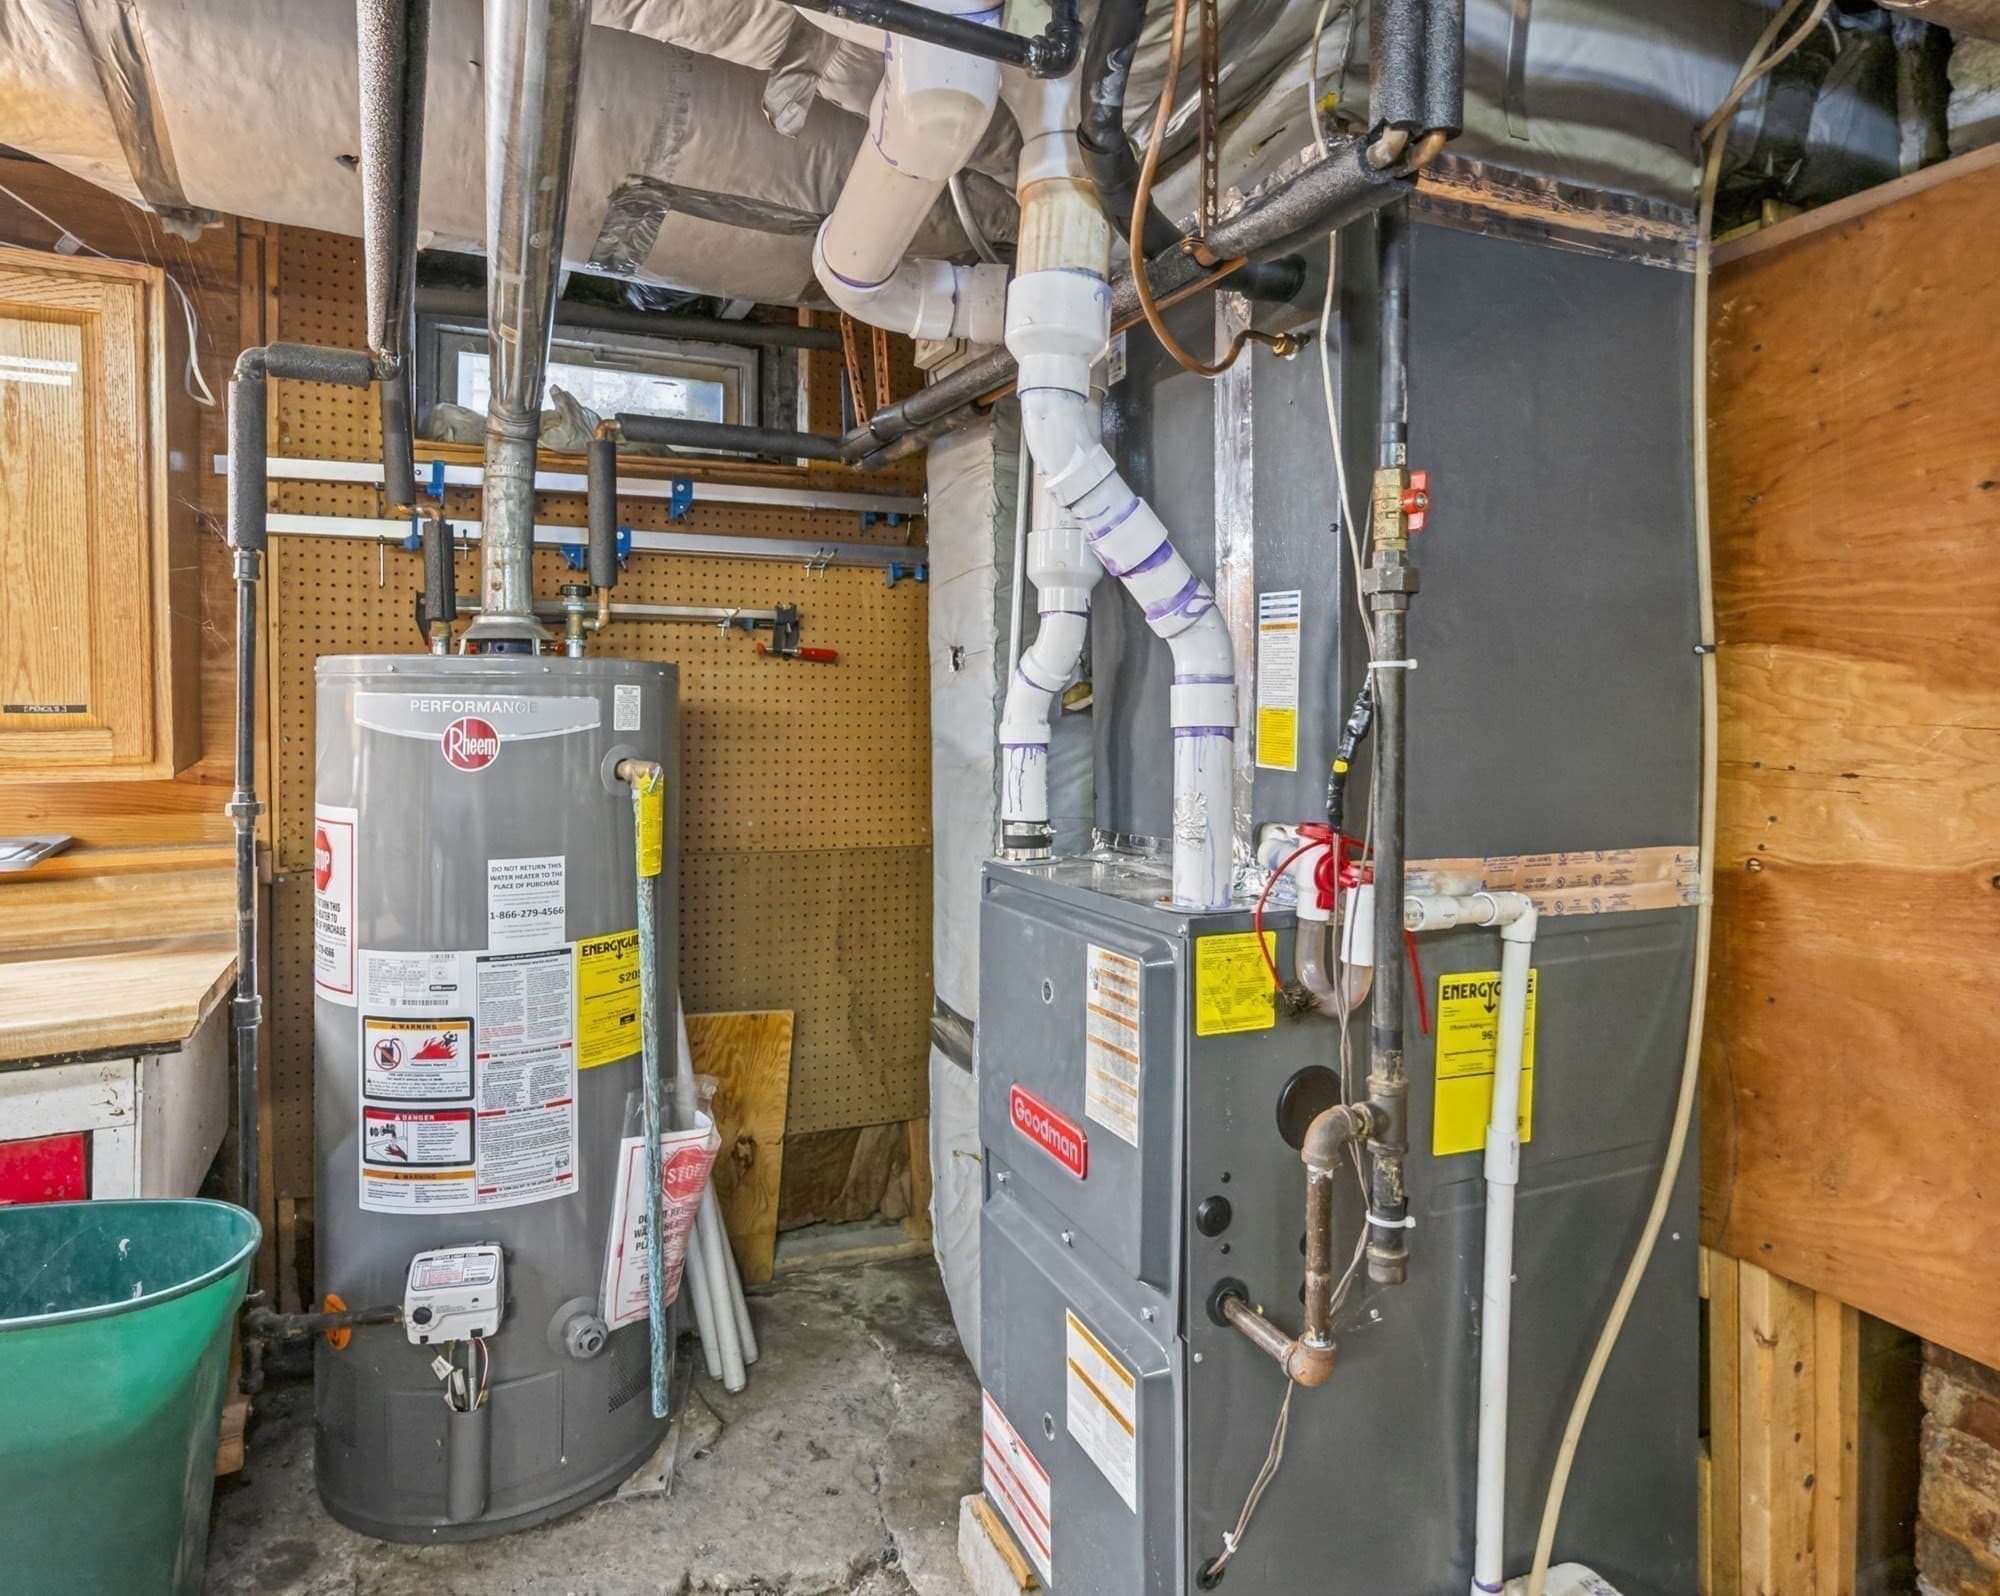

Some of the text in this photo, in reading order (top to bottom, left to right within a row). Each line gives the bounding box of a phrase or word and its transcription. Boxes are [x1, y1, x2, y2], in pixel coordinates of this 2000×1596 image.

[409, 699, 538, 714] PERFORMANCE
[448, 718, 497, 763] Rheem
[490, 873, 514, 881] WATER
[526, 880, 560, 888] PURCHASE
[490, 906, 564, 920] 1-866-279-4566
[322, 923, 347, 937] PURCHASE
[1014, 1096, 1079, 1165] Goodman
